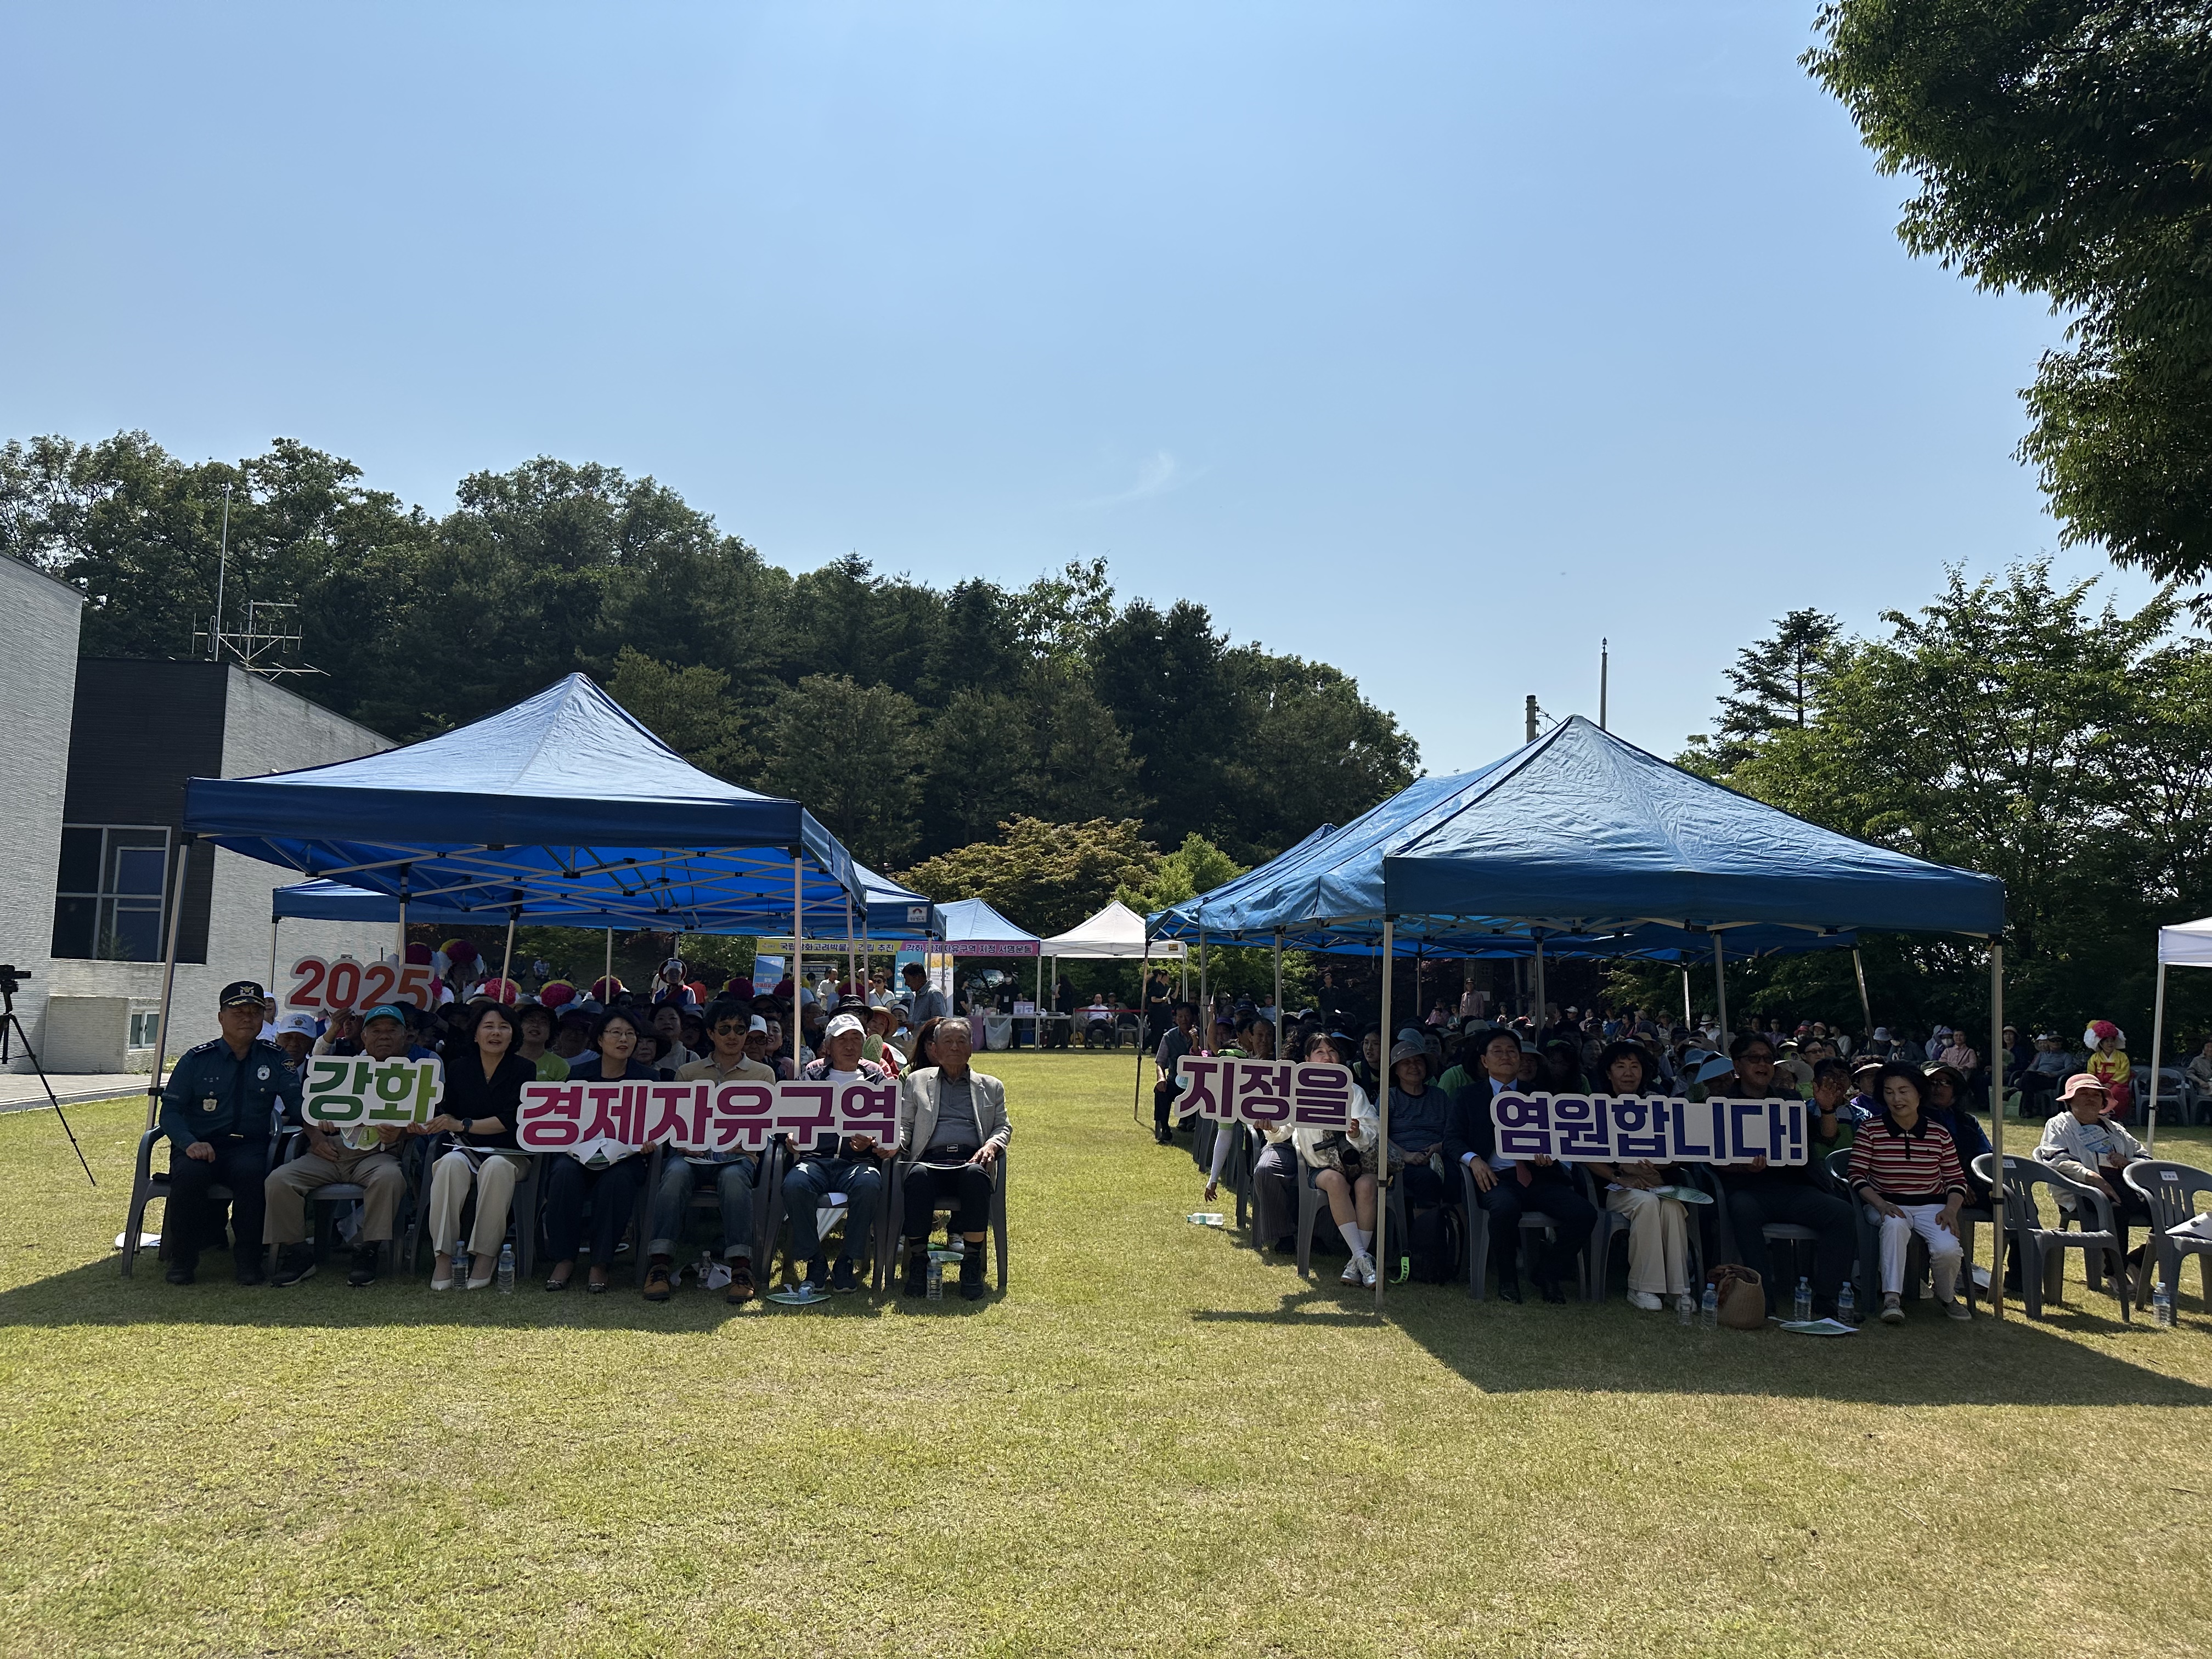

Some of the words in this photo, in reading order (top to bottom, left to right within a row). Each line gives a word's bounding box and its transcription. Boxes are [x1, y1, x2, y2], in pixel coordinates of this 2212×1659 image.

[878, 944, 894, 952] 추진
[979, 945, 996, 953] 지정
[998, 945, 1032, 953] 서명운동
[290, 960, 430, 1010] 2025
[309, 1062, 437, 1124] 강화
[523, 1085, 898, 1146] 경제자유구역
[1180, 1061, 1348, 1125] 지정을
[1496, 1096, 1802, 1160] 염원합니다!
